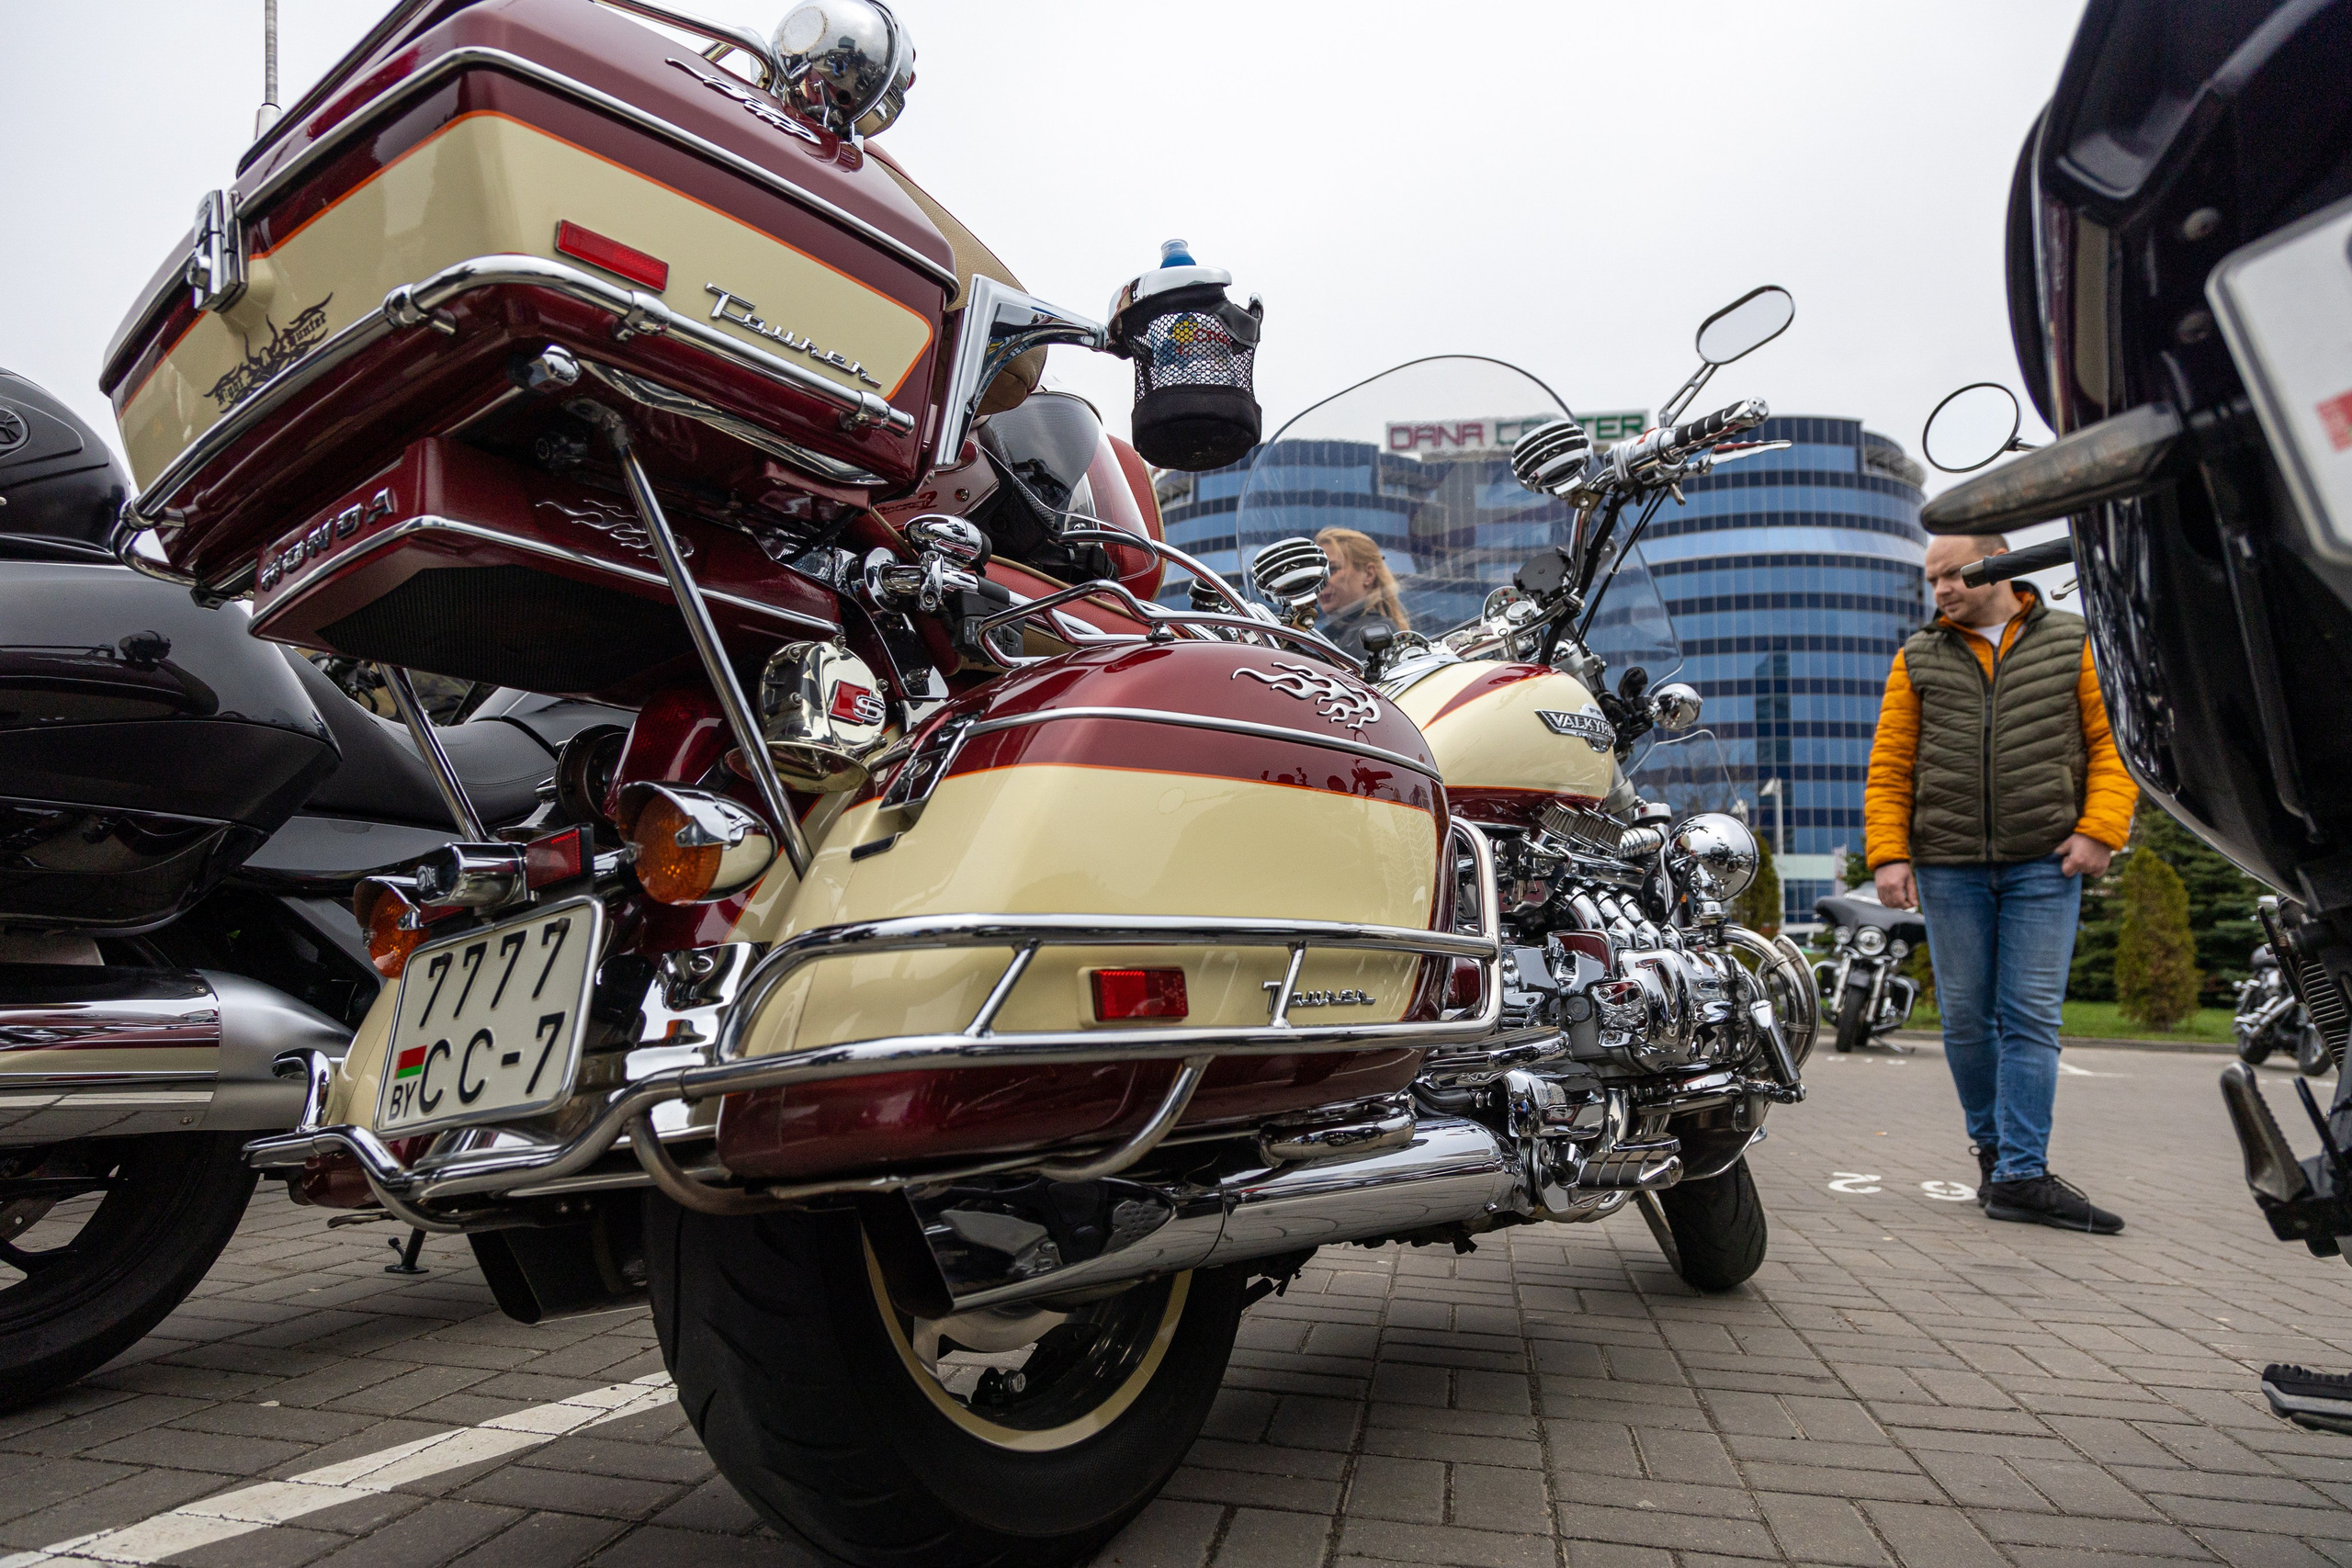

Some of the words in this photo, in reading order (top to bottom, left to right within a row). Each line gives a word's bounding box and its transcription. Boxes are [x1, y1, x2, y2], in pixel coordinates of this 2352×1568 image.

[705, 281, 882, 389] Tourer
[1389, 422, 1485, 449] DANA
[261, 487, 394, 592] HONDA
[419, 918, 574, 1029] 7777
[388, 1080, 417, 1122] BY
[419, 1011, 567, 1114] CC-7
